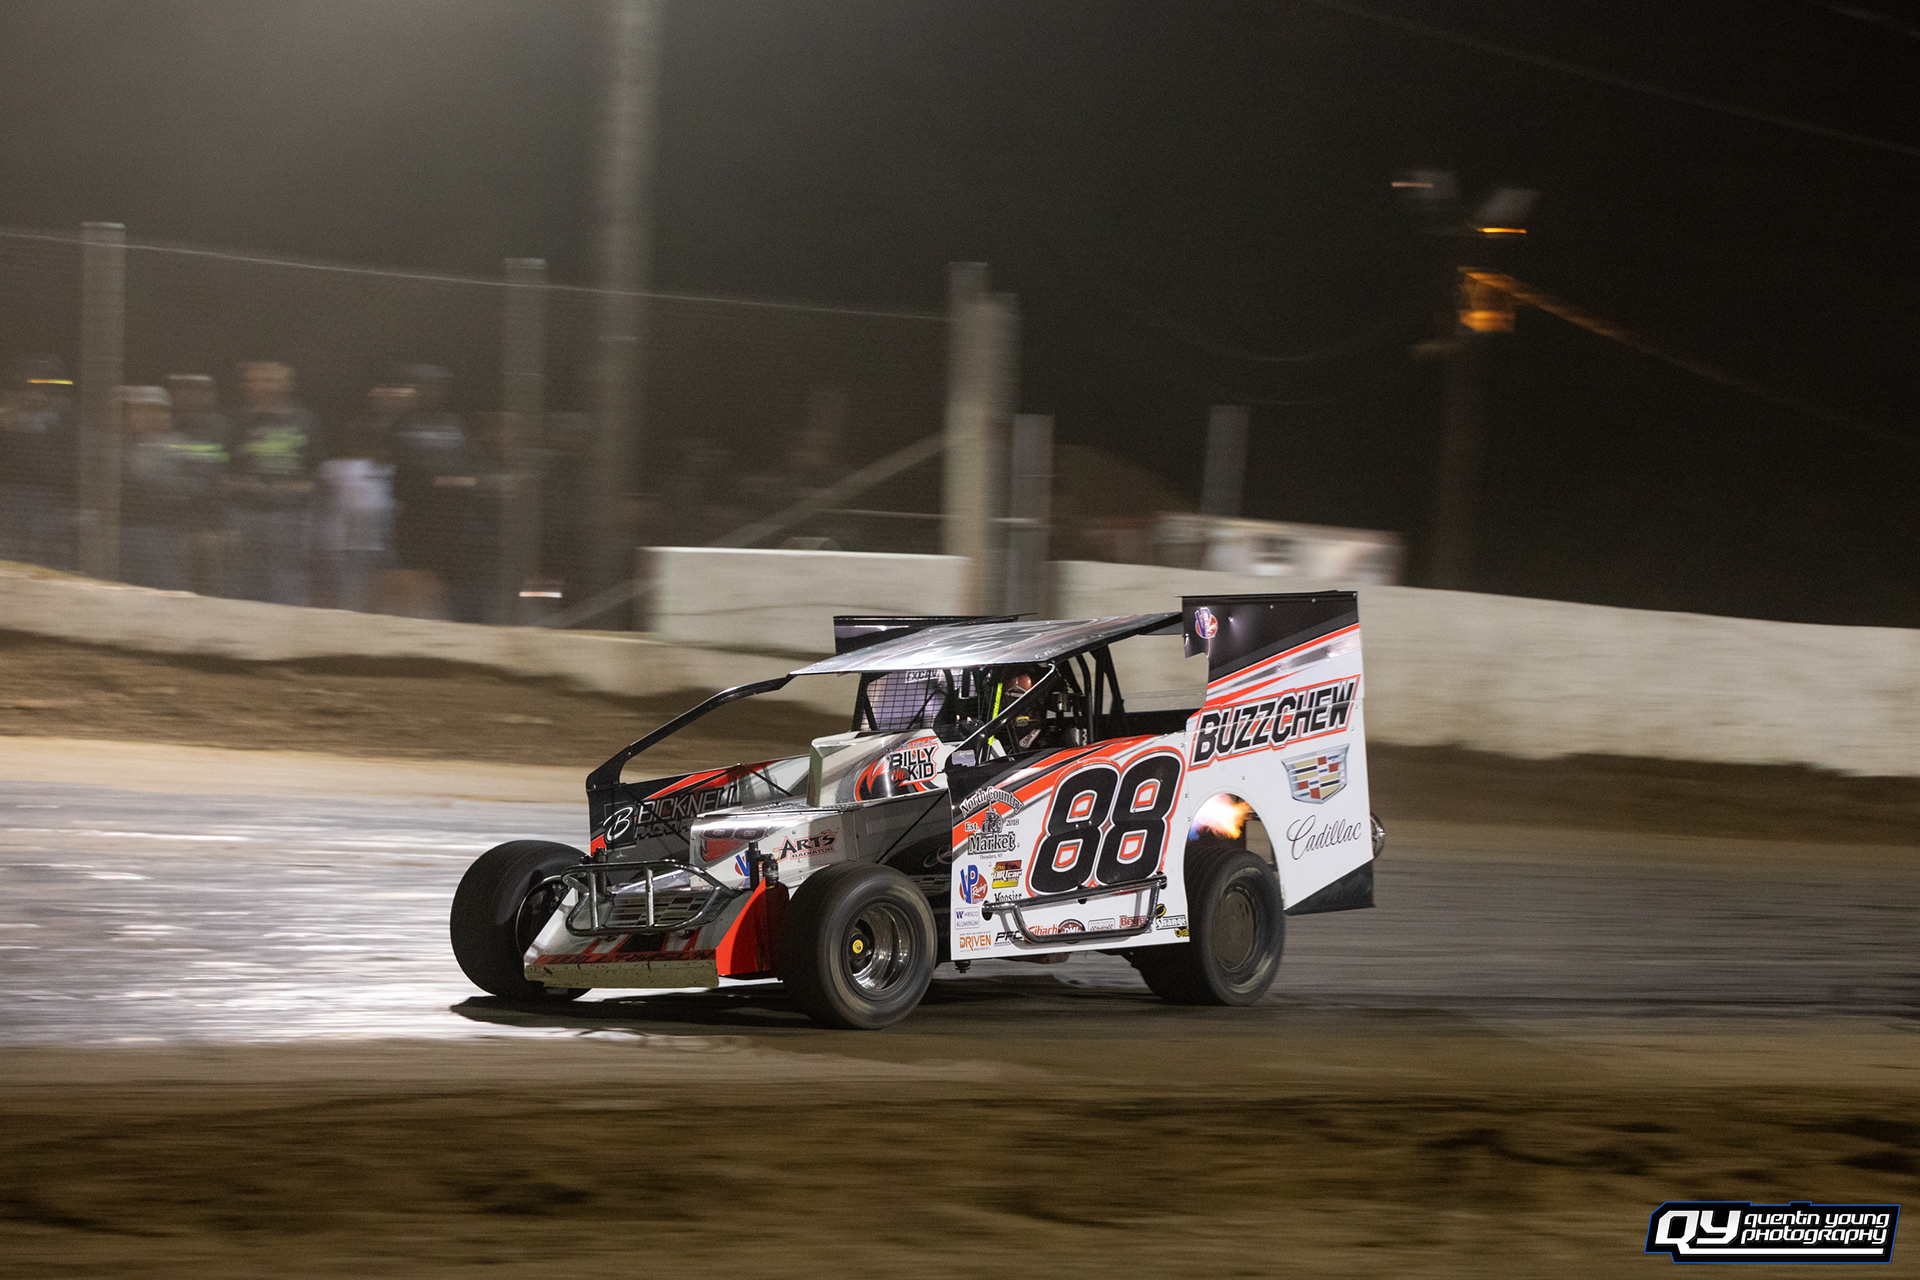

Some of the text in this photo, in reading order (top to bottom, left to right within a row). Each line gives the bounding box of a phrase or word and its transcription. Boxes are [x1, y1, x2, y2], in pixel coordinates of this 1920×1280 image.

[1191, 678, 1358, 764] BUZZCHEW
[889, 745, 937, 768] BILLY
[891, 763, 934, 782] the KID
[638, 784, 737, 824] BICKNELL
[960, 785, 1025, 818] North Country
[1029, 752, 1184, 894] 88
[779, 833, 836, 860] ARTS
[968, 831, 1016, 855] Market
[1287, 814, 1362, 860] Cadillac
[792, 847, 834, 858] RADIATOR
[959, 864, 979, 905] VP
[959, 934, 992, 952] DRIVEN
[995, 931, 1023, 942] PFC
